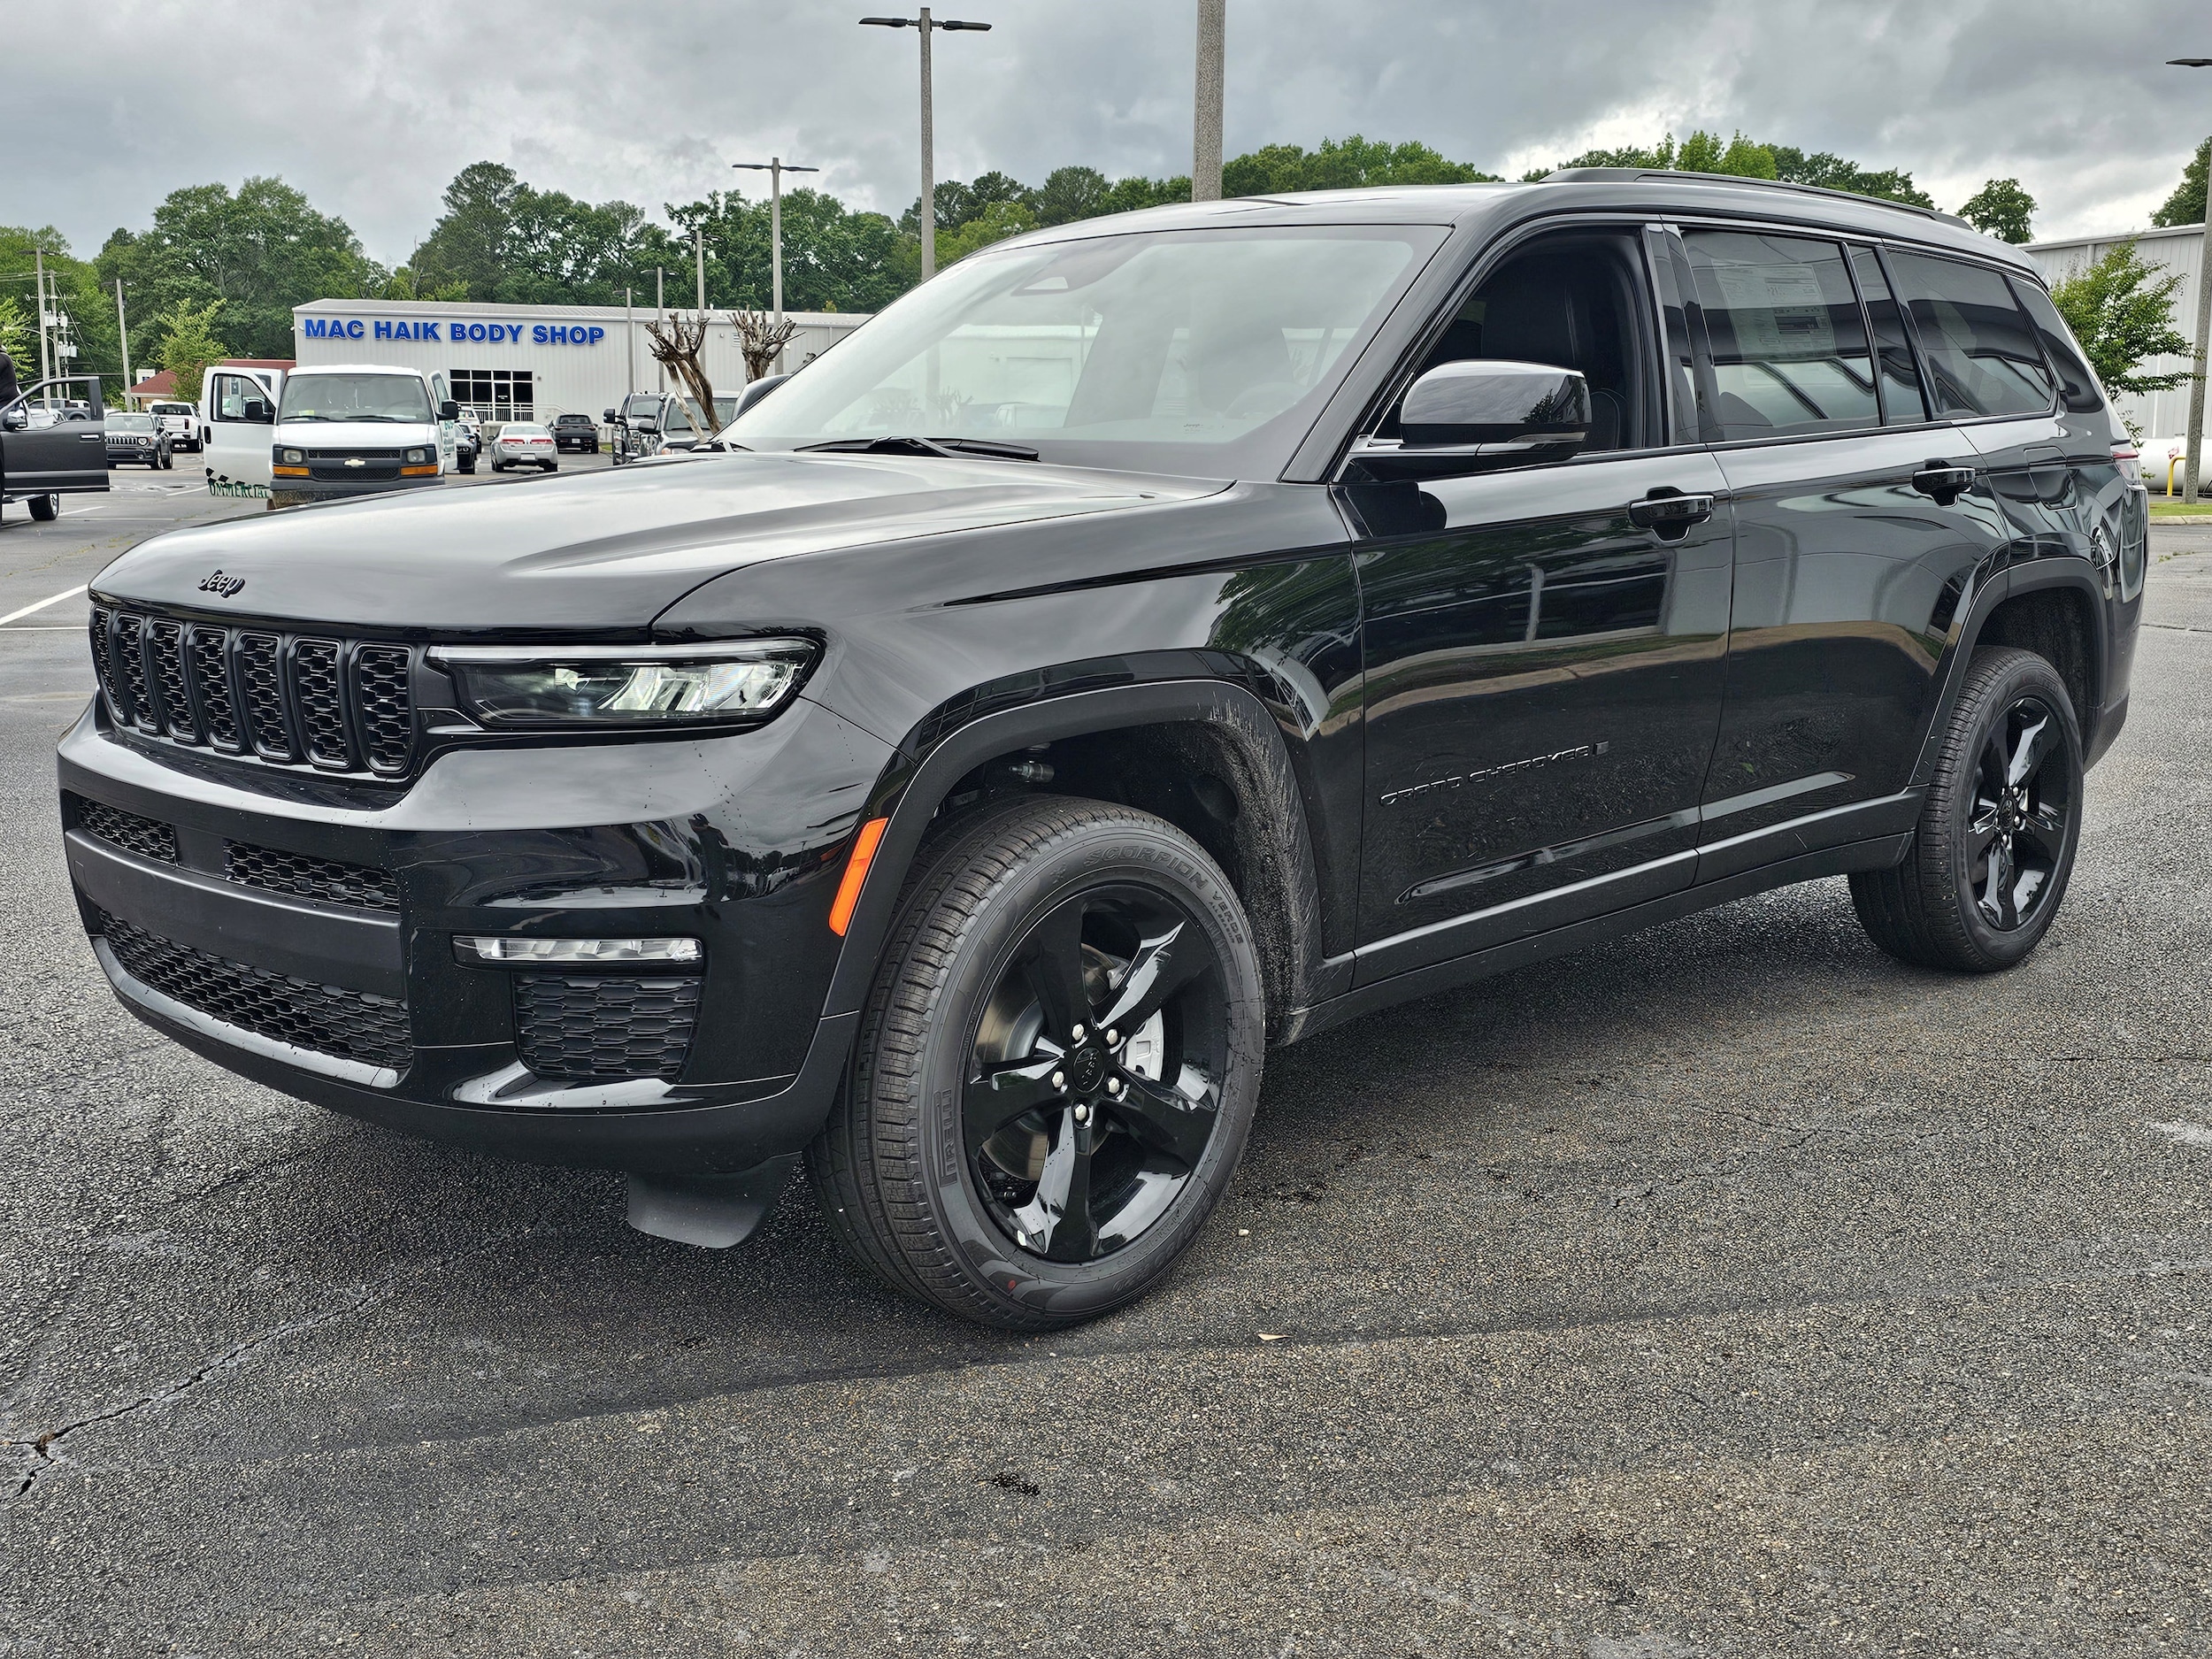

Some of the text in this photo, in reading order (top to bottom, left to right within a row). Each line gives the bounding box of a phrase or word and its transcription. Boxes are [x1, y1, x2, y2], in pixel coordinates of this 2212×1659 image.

[304, 319, 605, 345] MAC HAIK BODY SHOP
[197, 569, 246, 599] Jeep
[1379, 775, 1463, 807] GRAND
[1469, 744, 1590, 783] CHEROKEE
[1083, 845, 1244, 944] SCORPION VERDE
[933, 1088, 958, 1187] PIRELLI
